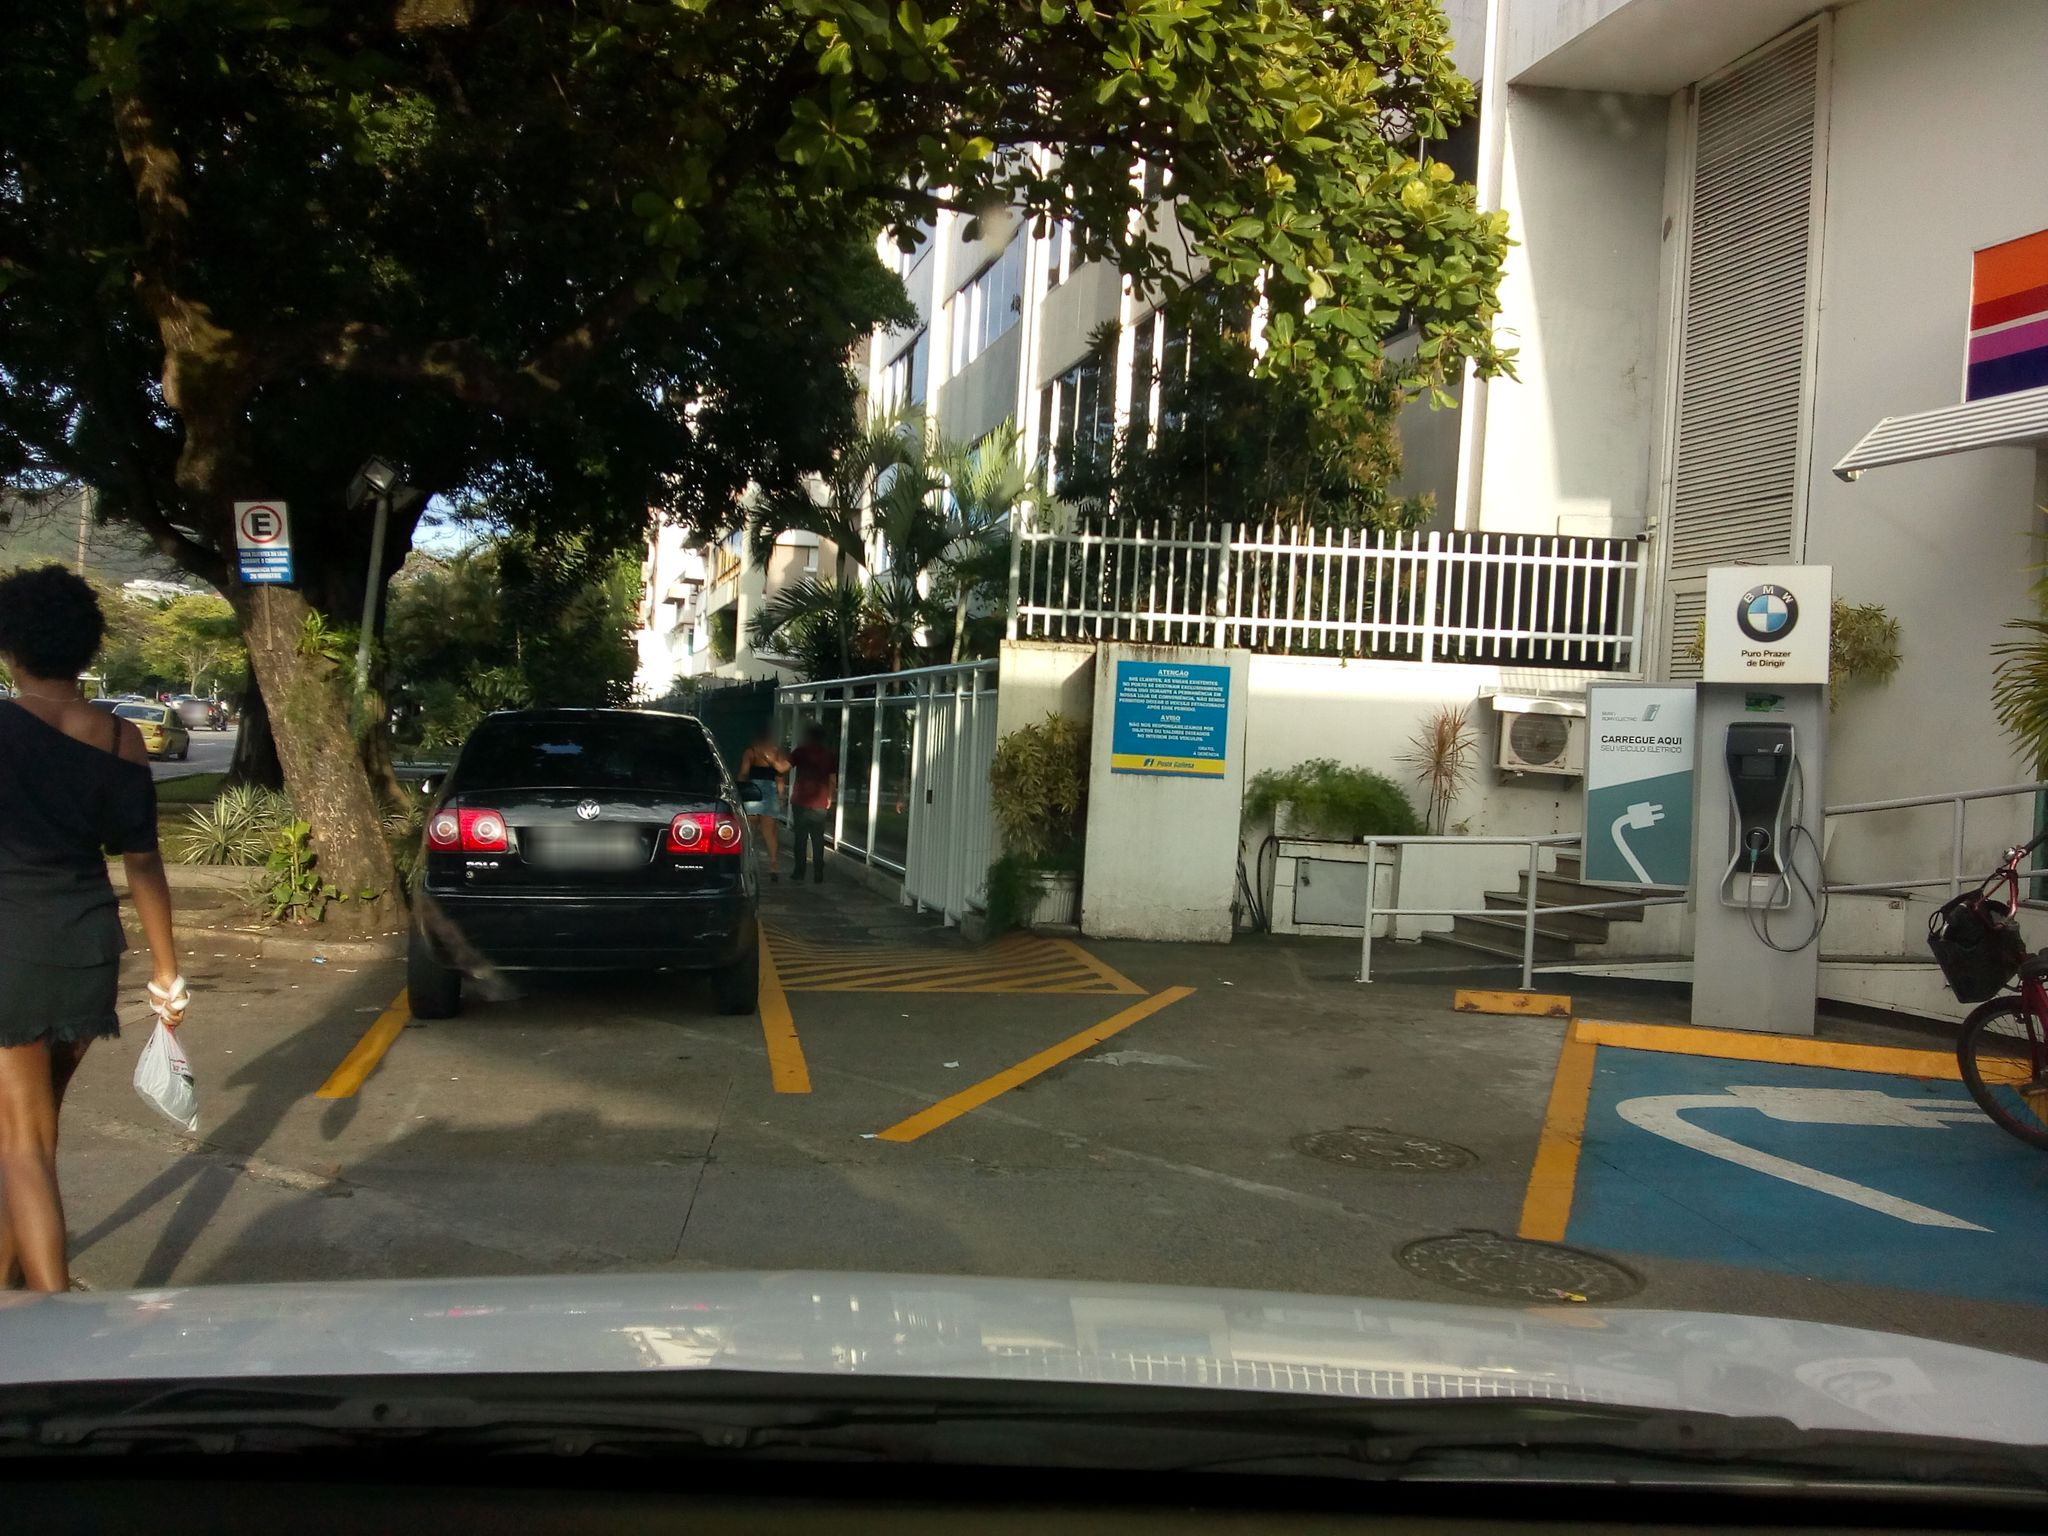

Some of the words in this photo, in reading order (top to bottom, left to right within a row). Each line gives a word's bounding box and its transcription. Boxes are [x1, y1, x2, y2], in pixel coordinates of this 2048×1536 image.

[251, 513, 272, 536] E
[1744, 585, 1794, 604] BMW
[1759, 660, 1785, 668] Dirigir
[1601, 736, 1655, 744] CARREGUE
[1657, 736, 1682, 745] AQUI
